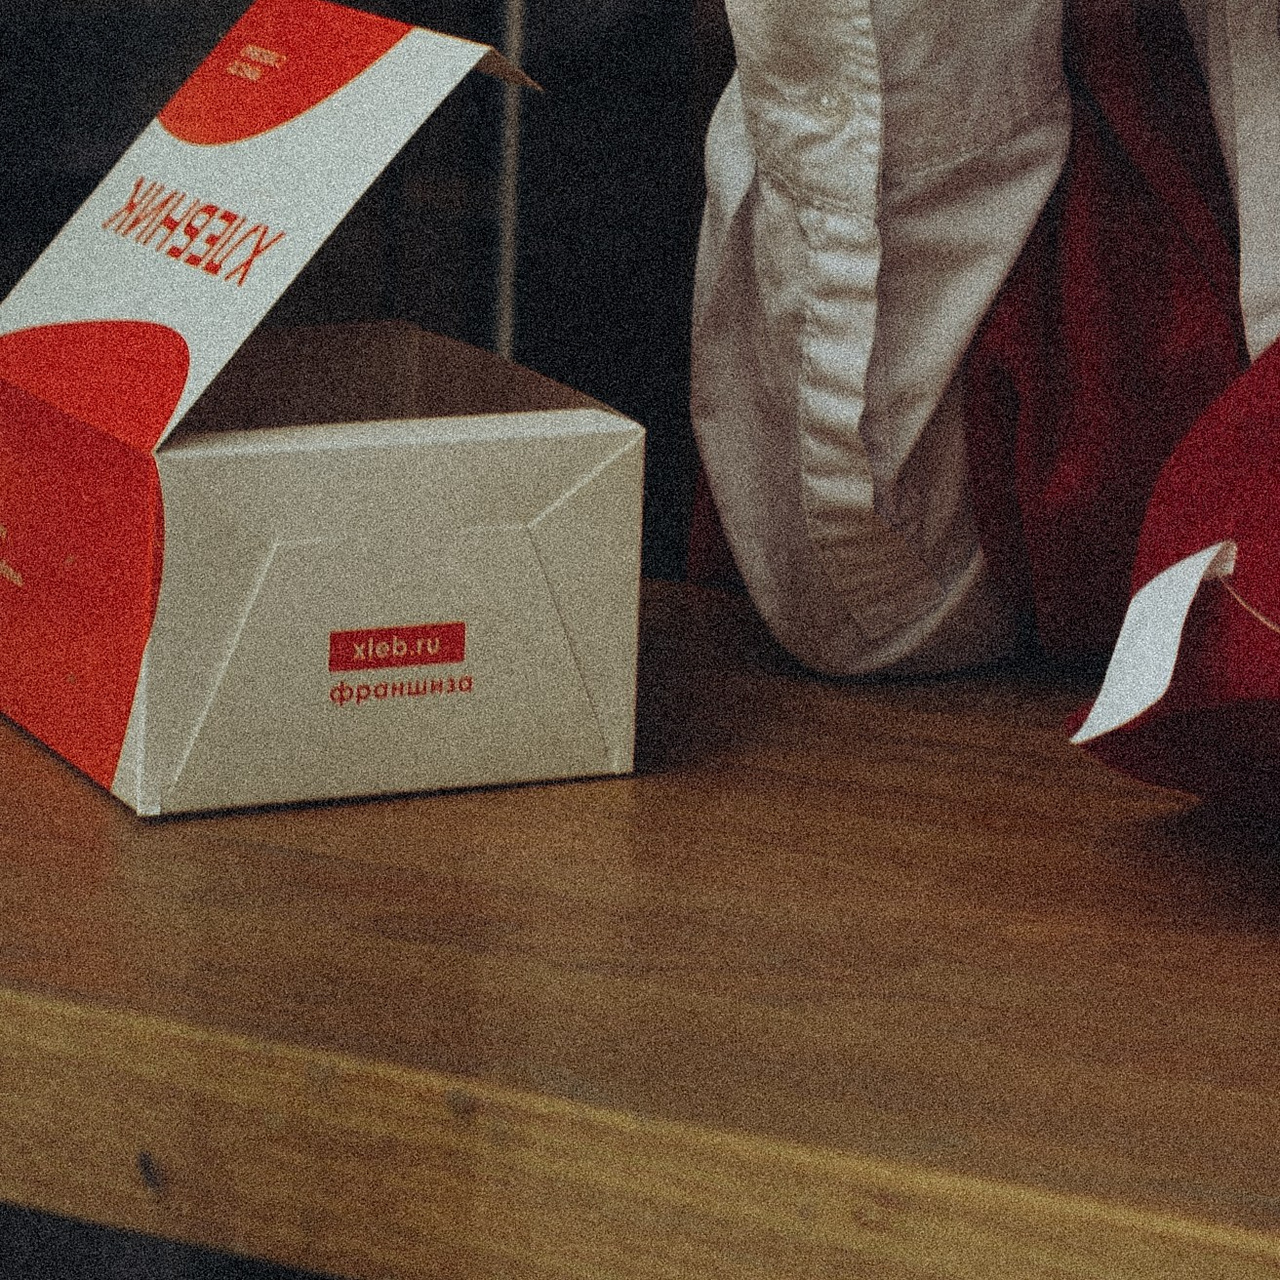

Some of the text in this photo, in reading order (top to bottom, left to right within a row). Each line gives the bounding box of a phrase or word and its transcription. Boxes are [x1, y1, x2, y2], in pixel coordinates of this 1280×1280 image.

[103, 177, 286, 288] ХЛЕБНИК
[352, 635, 442, 661] xleb.ru
[328, 674, 474, 708] франшиза
